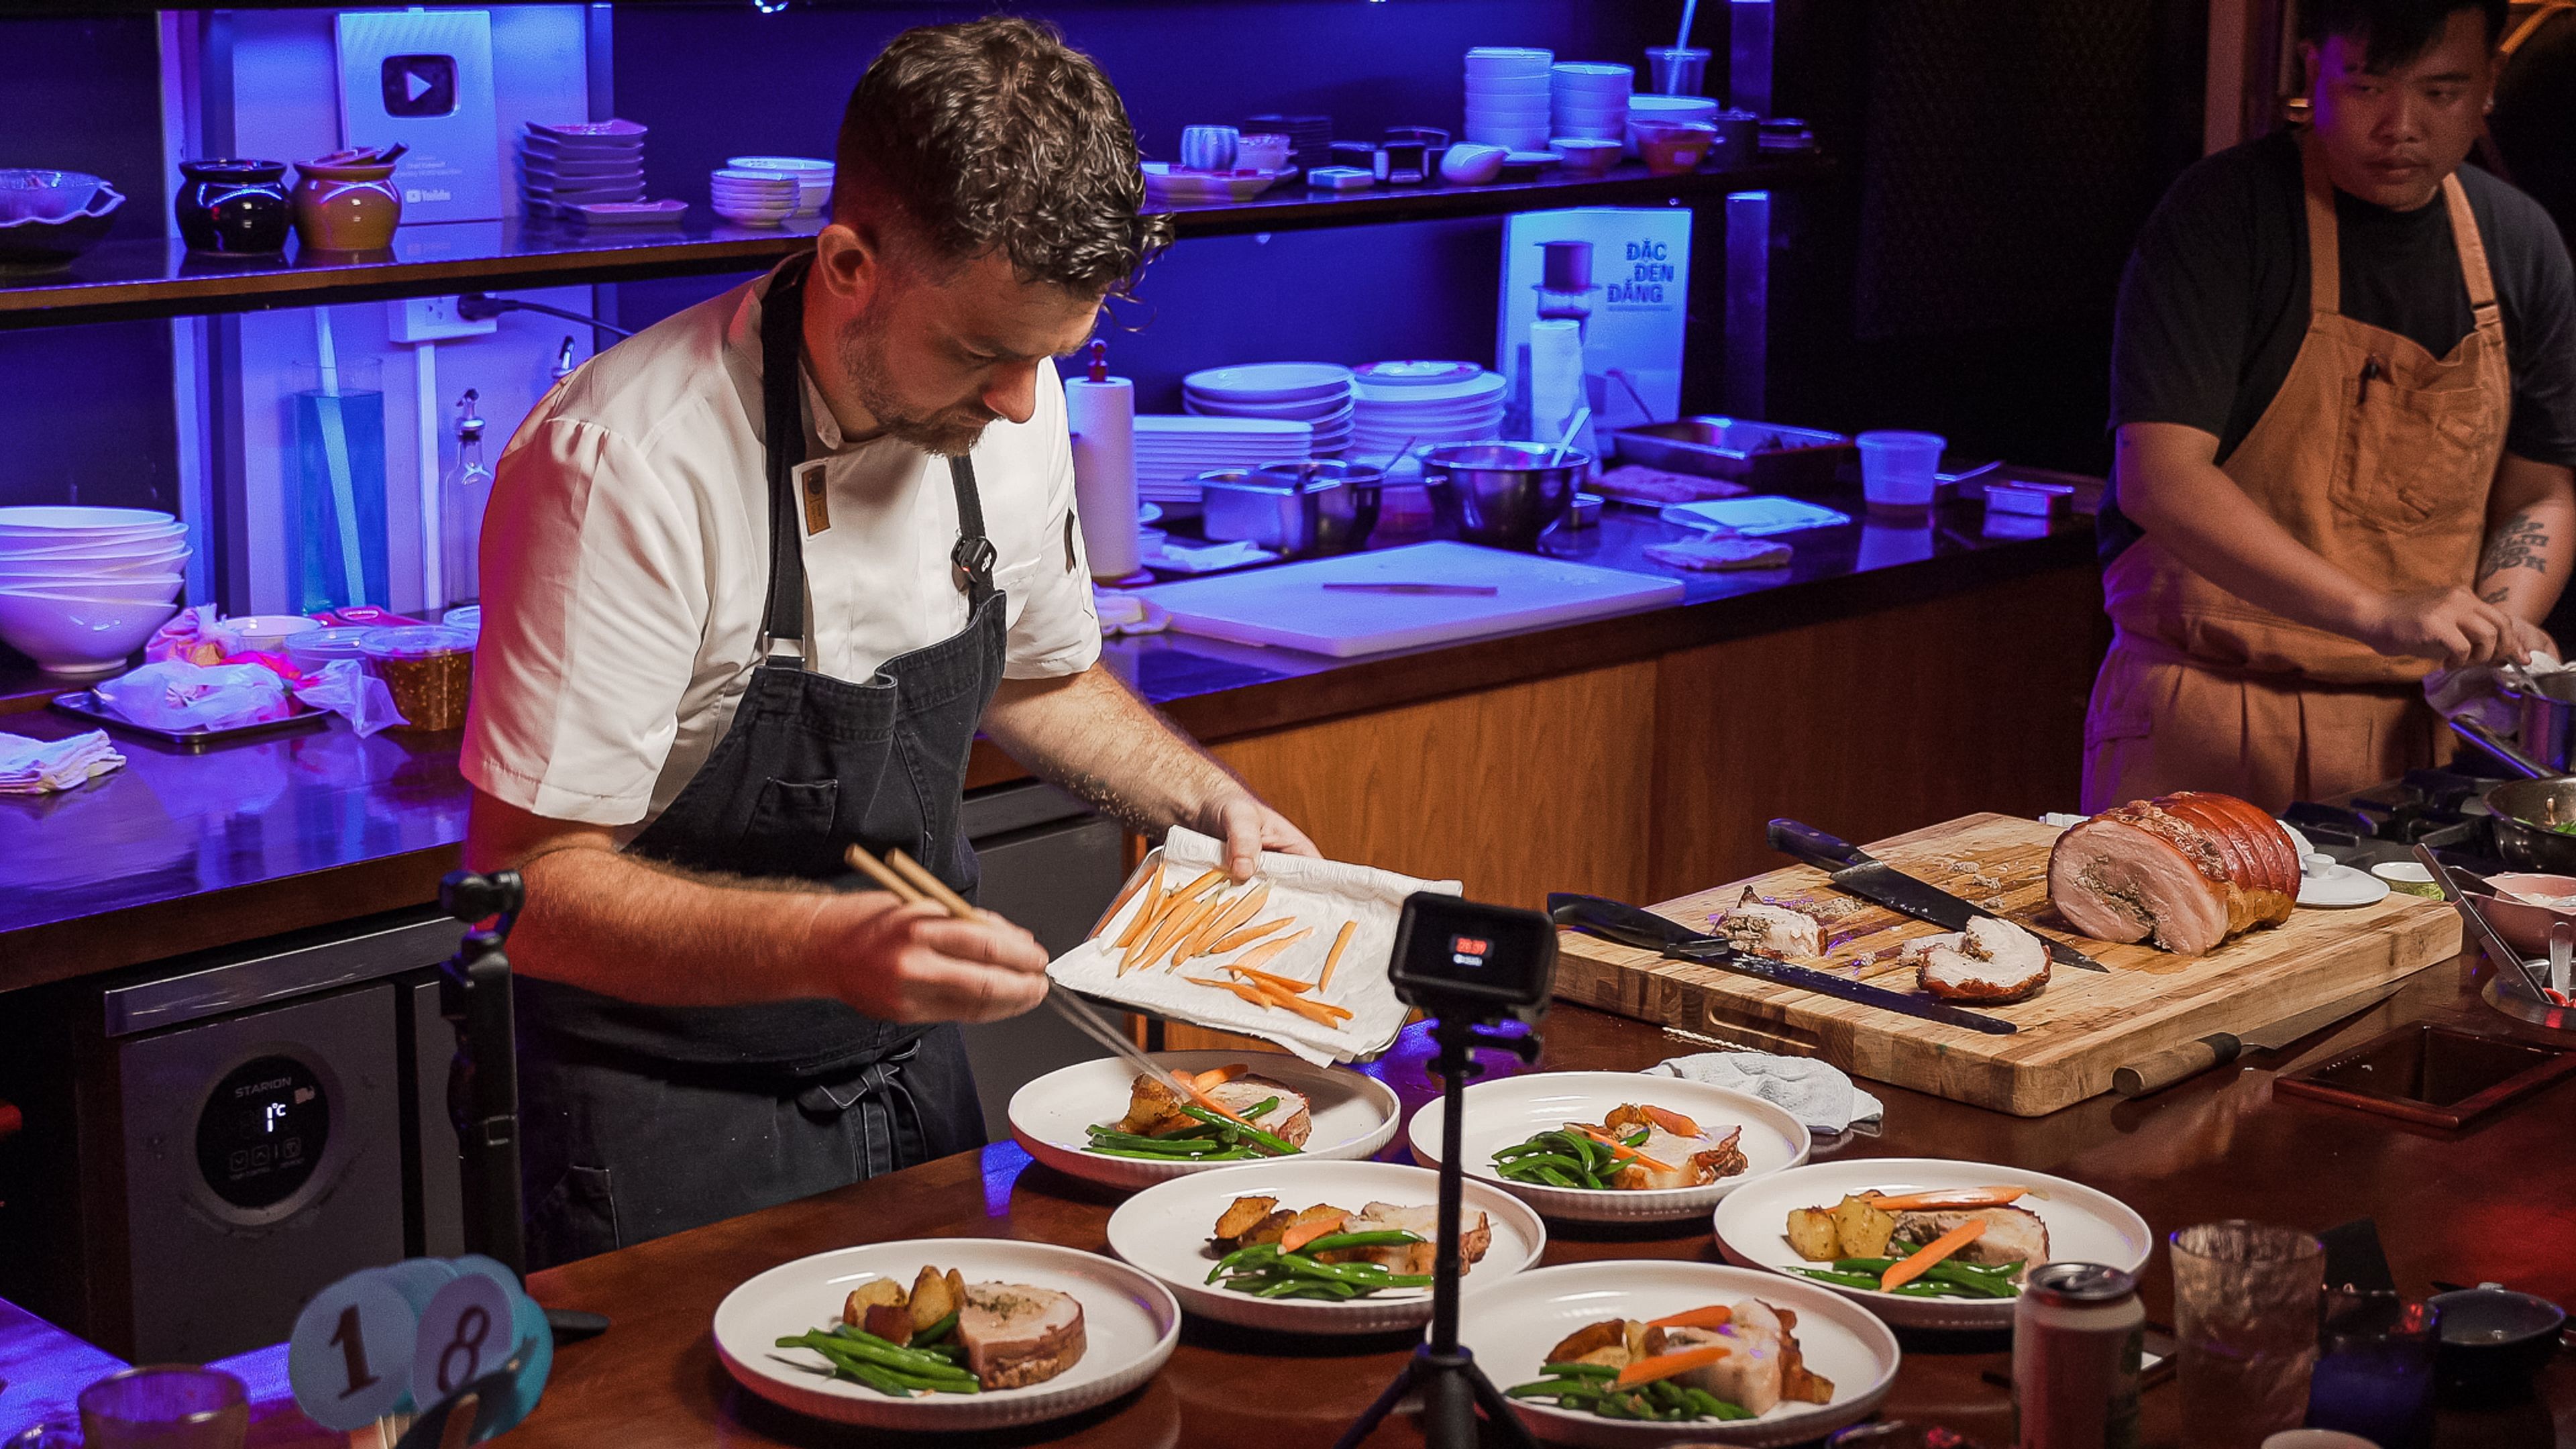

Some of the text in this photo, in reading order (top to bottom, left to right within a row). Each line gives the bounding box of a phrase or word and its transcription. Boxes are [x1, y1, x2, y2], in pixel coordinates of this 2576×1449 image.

[235, 1077, 292, 1098] STARION
[329, 1303, 381, 1400] 1
[437, 1304, 491, 1393] 8
